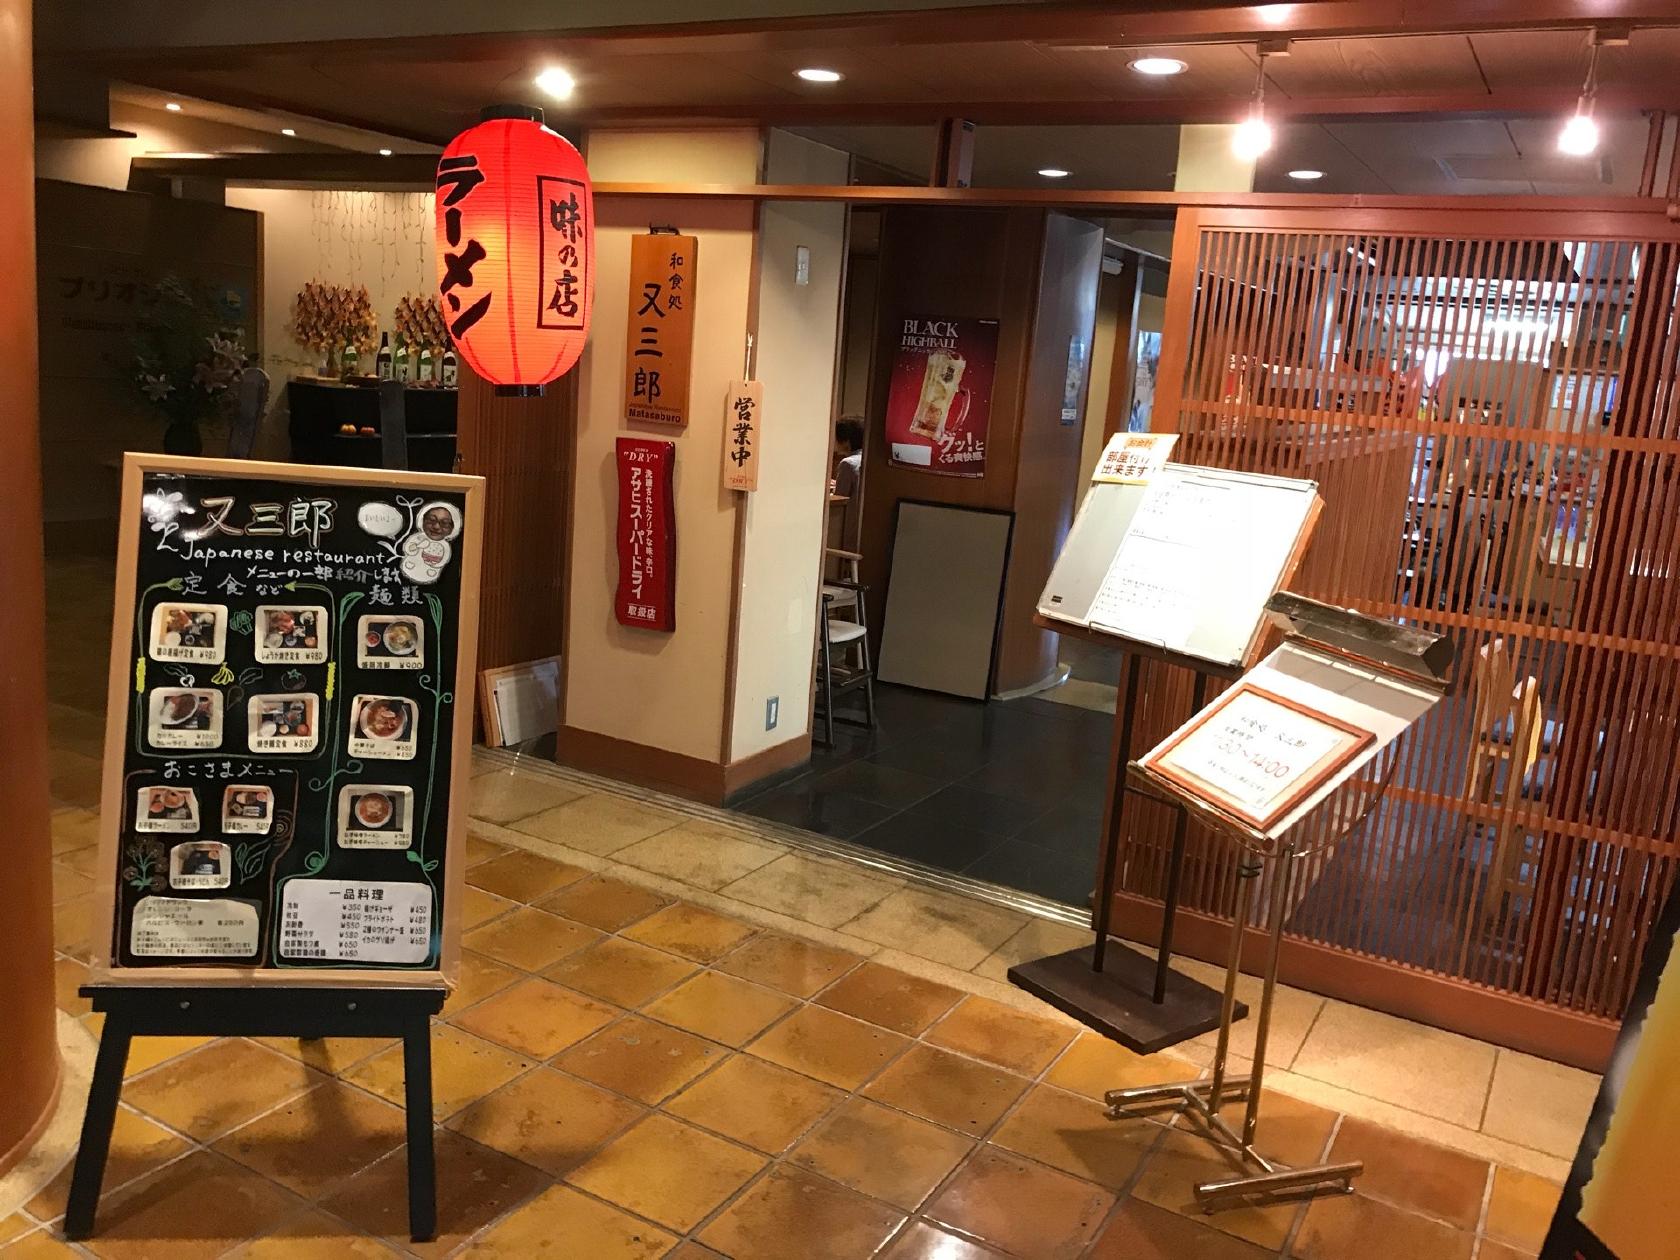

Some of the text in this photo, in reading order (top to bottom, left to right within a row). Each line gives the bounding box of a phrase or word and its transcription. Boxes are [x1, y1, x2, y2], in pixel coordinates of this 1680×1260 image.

[437, 155, 492, 340] ラーメン
[546, 192, 583, 318] 味の店
[668, 252, 684, 310] 和食処
[633, 283, 666, 403] 又三郎
[901, 335, 957, 349] HIGHBALL
[903, 319, 959, 338] BLACK
[629, 408, 682, 423] Matasaburo
[731, 397, 755, 468] 営業中
[192, 496, 338, 548] 又三郎
[629, 467, 645, 599] アサヒスーパードライ
[181, 538, 385, 568] Japanese restaurant
[368, 584, 424, 606] 麺類
[164, 760, 294, 779] おこさまメニュー
[329, 888, 384, 901] 一品料理
